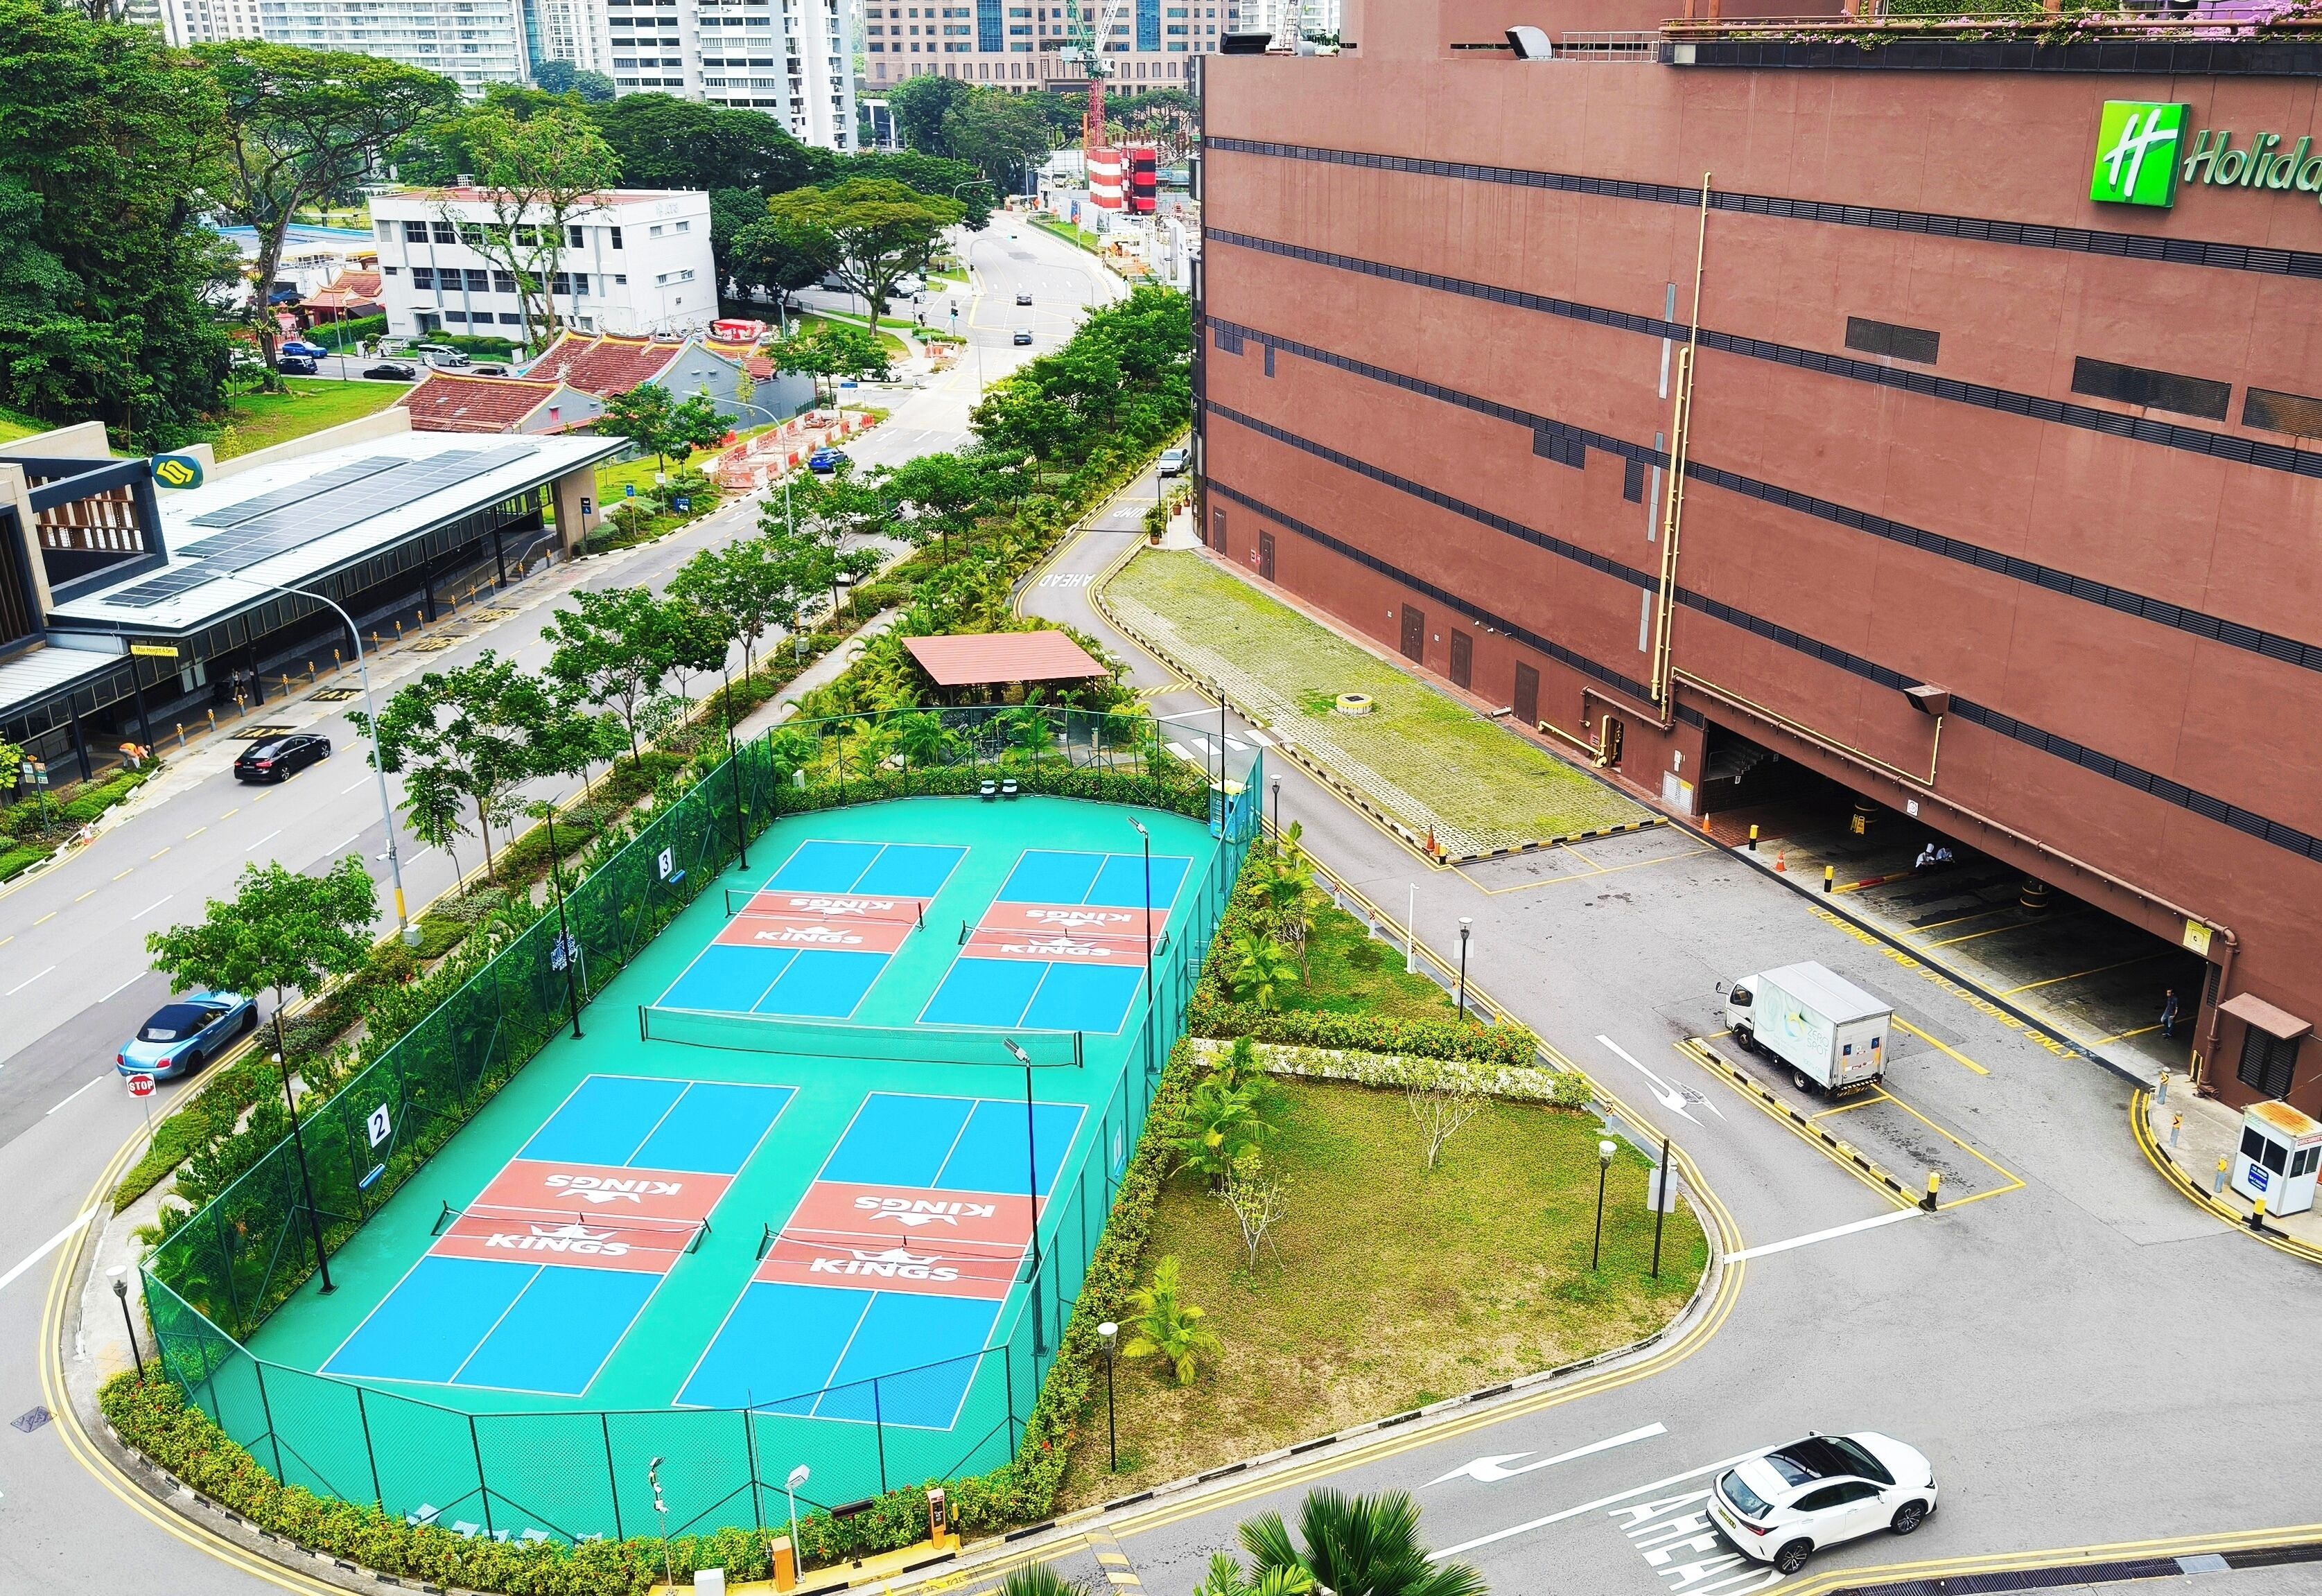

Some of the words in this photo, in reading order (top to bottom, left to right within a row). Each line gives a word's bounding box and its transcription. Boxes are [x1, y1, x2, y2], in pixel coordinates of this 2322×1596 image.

[2184, 130, 2322, 207] Holida
[1038, 573, 1097, 588] AHEAD
[663, 854, 669, 872] 3
[789, 897, 895, 911] KINGS
[1025, 909, 1133, 922] KINGS
[753, 931, 864, 944] KINGS
[1000, 944, 1111, 956] KINGS
[1806, 905, 1881, 945] LOADING
[1878, 947, 1920, 968] AND
[1918, 969, 2025, 1028] UNLOADING
[2023, 1029, 2082, 1059] ONLY
[1807, 1026, 1829, 1047] ZERO
[1806, 1037, 1828, 1058] SPOT
[129, 1080, 153, 1091] STOP
[374, 1113, 385, 1140] 2
[543, 1174, 683, 1196] KINGS
[853, 1196, 996, 1218] KINGS
[485, 1234, 631, 1256] KINGS
[809, 1258, 960, 1282] KINGS
